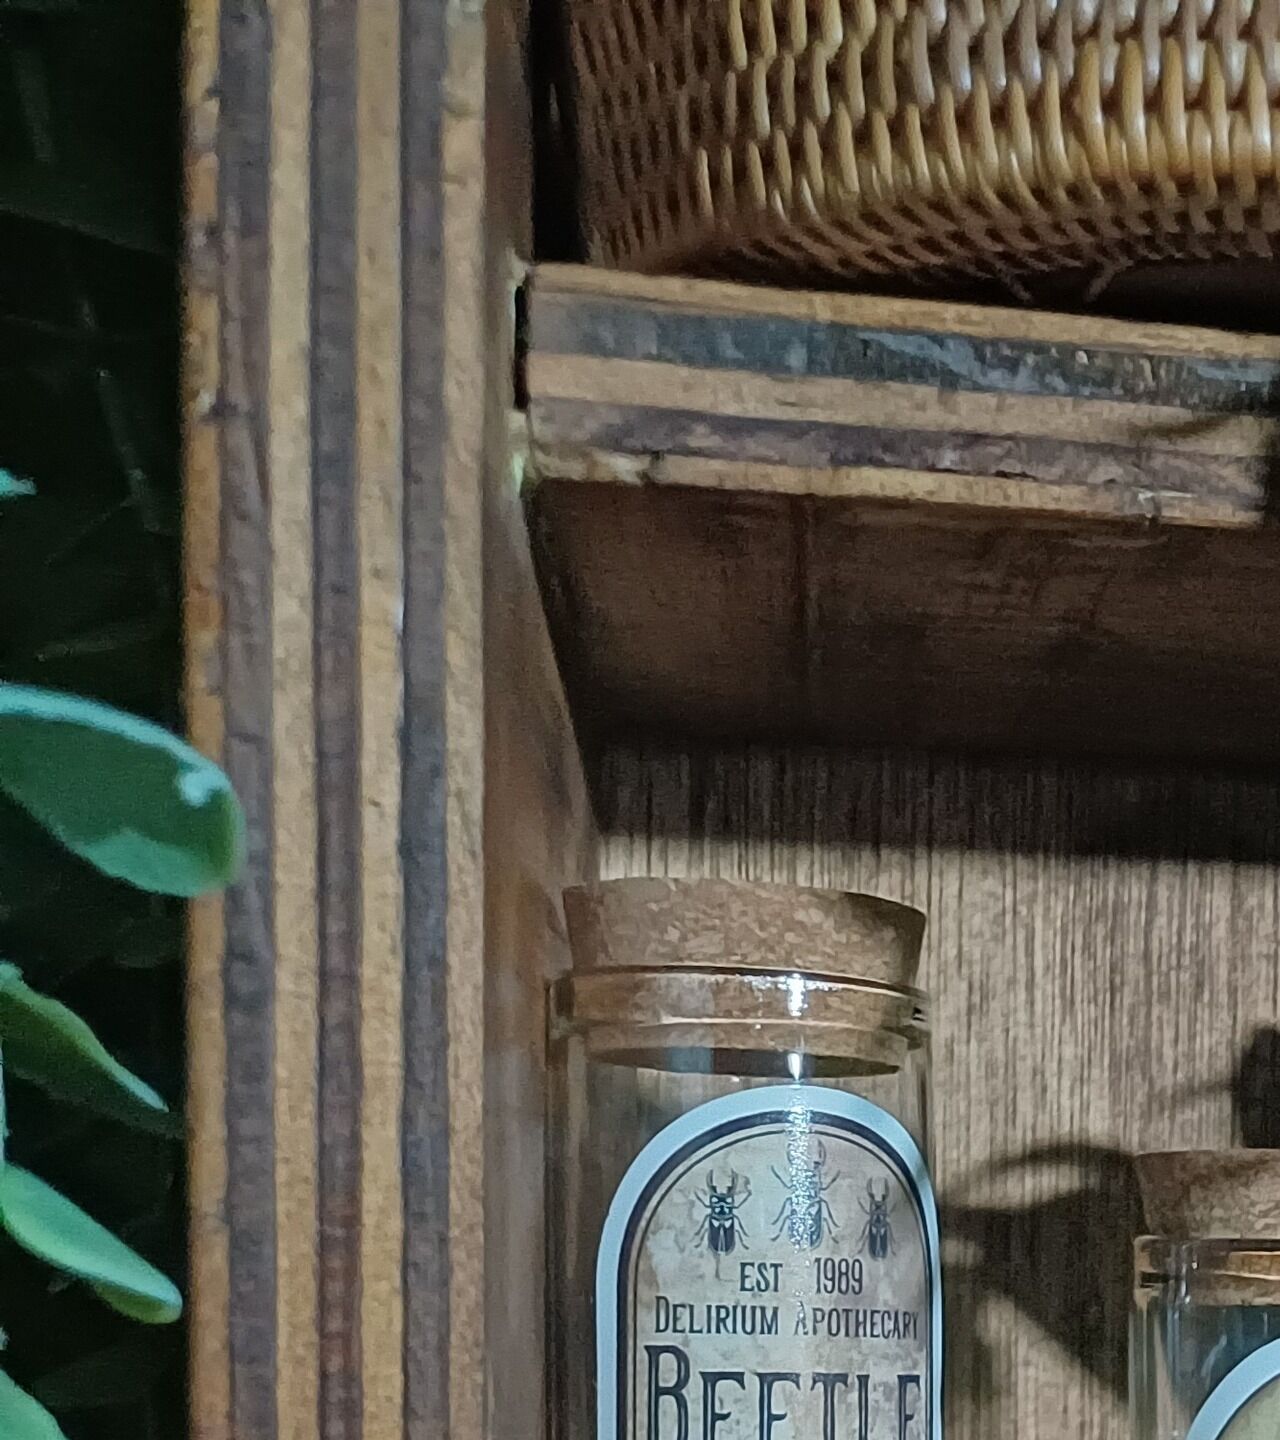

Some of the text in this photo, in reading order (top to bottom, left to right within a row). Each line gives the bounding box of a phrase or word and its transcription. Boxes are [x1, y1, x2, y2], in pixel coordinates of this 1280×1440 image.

[739, 1257, 863, 1296] EST 1989
[654, 1295, 919, 1340] DELIRIUM APOTHECARY
